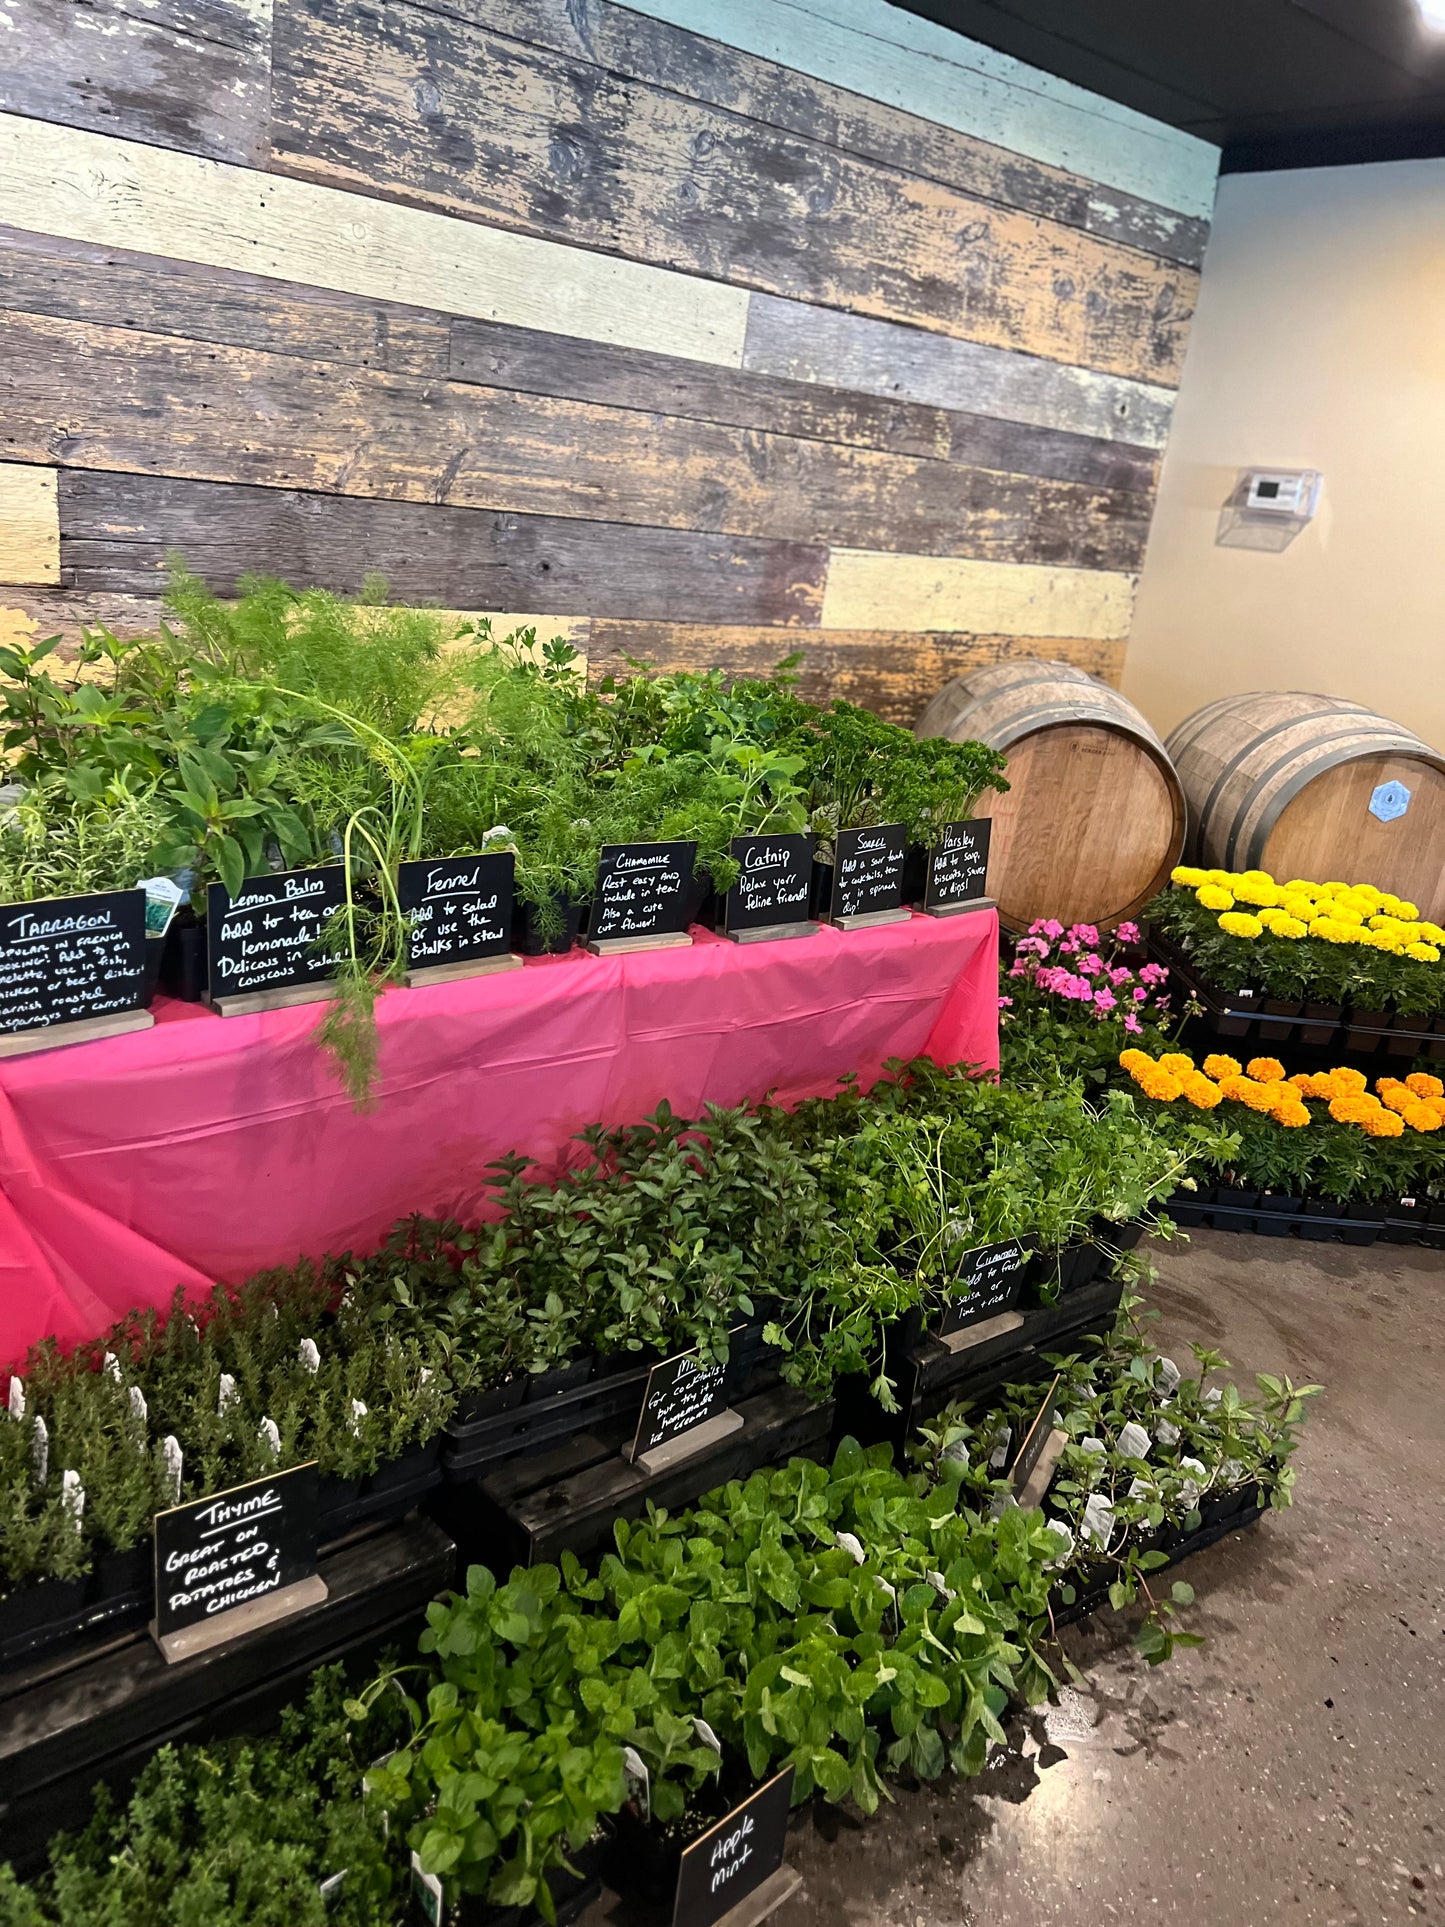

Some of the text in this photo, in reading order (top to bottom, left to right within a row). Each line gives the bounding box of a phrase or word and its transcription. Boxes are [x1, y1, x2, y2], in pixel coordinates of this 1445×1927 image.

[943, 825, 975, 849] Parsley
[744, 846, 791, 868] Catnip
[841, 858, 857, 873] Add
[859, 860, 866, 869] a
[934, 856, 948, 871] Add
[950, 853, 959, 866] to
[283, 877, 324, 899] Balm
[426, 866, 481, 894] Fennel
[601, 875, 627, 892] Rest
[632, 876, 656, 887] easy
[739, 875, 767, 896] Relax
[838, 876, 848, 888] to
[939, 877, 969, 897] or dips!
[603, 878, 681, 904] include in tea!
[744, 881, 809, 911] feline friend!
[841, 891, 851, 900] or
[857, 888, 864, 897] in
[7, 910, 111, 938] TARRAGON
[220, 904, 340, 942] Add to tea or
[410, 905, 434, 926] Add
[443, 901, 457, 916] to
[467, 913, 492, 927] the
[602, 907, 621, 920] Also
[626, 908, 635, 916] a
[597, 915, 656, 934] cut flower!
[241, 922, 321, 957] lemonade!
[0, 944, 50, 958] OPULAR
[59, 949, 86, 963] Add
[92, 945, 105, 956] to
[113, 941, 130, 952] an
[286, 951, 302, 963] in
[54, 966, 77, 975] use
[82, 963, 95, 971] in
[47, 981, 62, 991] or
[52, 986, 107, 1006] roasted
[70, 1004, 86, 1015] or
[91, 992, 138, 1011] carrots!
[987, 1267, 998, 1279] to
[990, 1279, 1004, 1291] or
[165, 1525, 259, 1572] GREAT ON
[184, 1542, 269, 1586] ROASTED
[168, 1568, 256, 1611] POTATOES
[205, 1571, 281, 1613] CHICKEN
[710, 1815, 755, 1868] Apple
